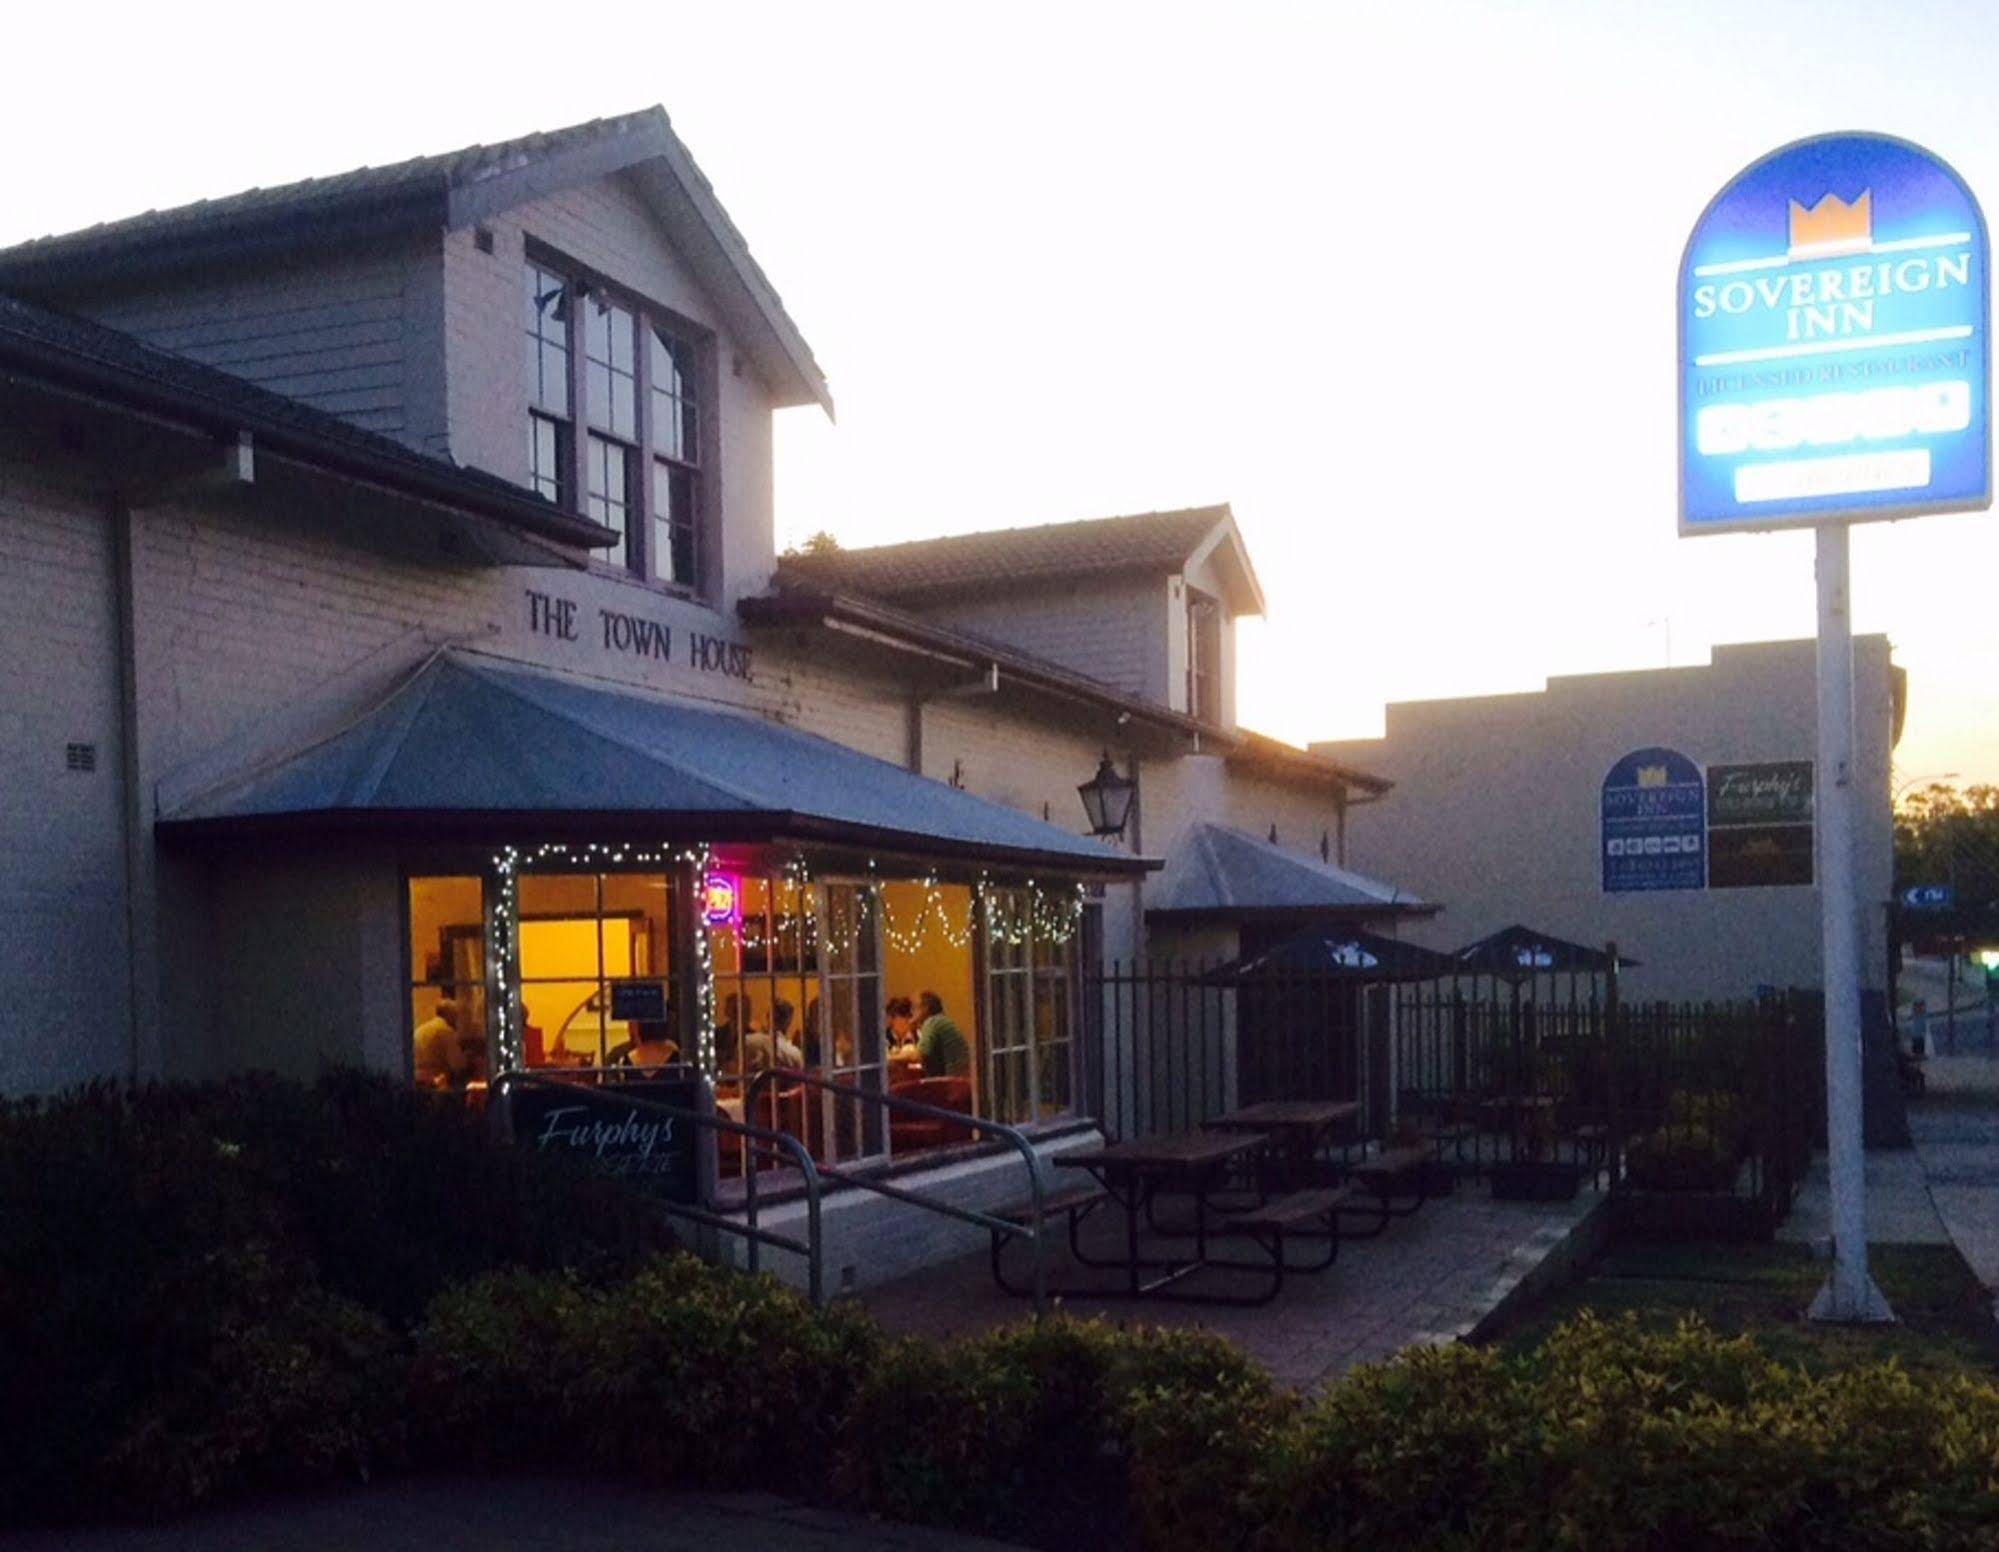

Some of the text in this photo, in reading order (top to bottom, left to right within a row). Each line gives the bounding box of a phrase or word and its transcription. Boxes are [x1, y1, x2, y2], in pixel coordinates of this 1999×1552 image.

[1694, 252, 1971, 318] SOVEREIGN
[1786, 299, 1875, 340] INN
[525, 589, 755, 684] THE TOWN HOUSE
